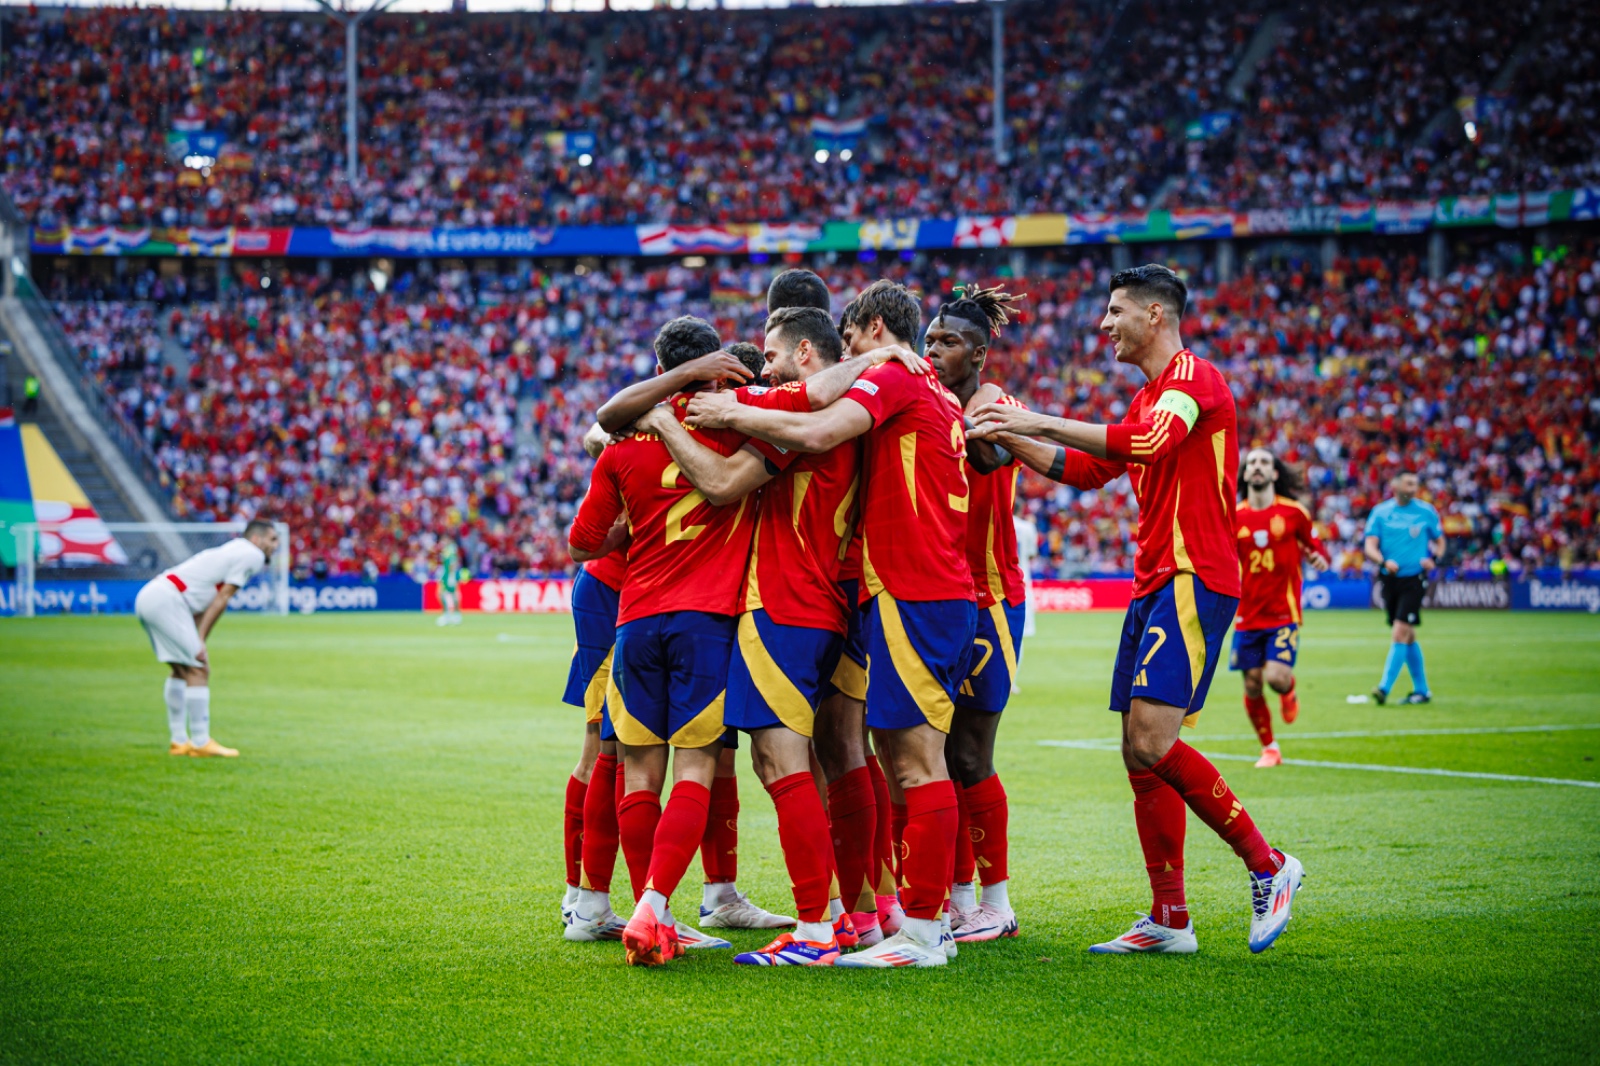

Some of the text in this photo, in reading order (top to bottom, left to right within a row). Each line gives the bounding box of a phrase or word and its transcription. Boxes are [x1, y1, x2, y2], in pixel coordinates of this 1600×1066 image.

[947, 419, 970, 514] 3
[660, 461, 708, 546] 2
[1249, 549, 1275, 574] 24
[1433, 580, 1508, 608] AIRWAYS
[1529, 579, 1599, 613] Booking
[1141, 626, 1167, 665] 7
